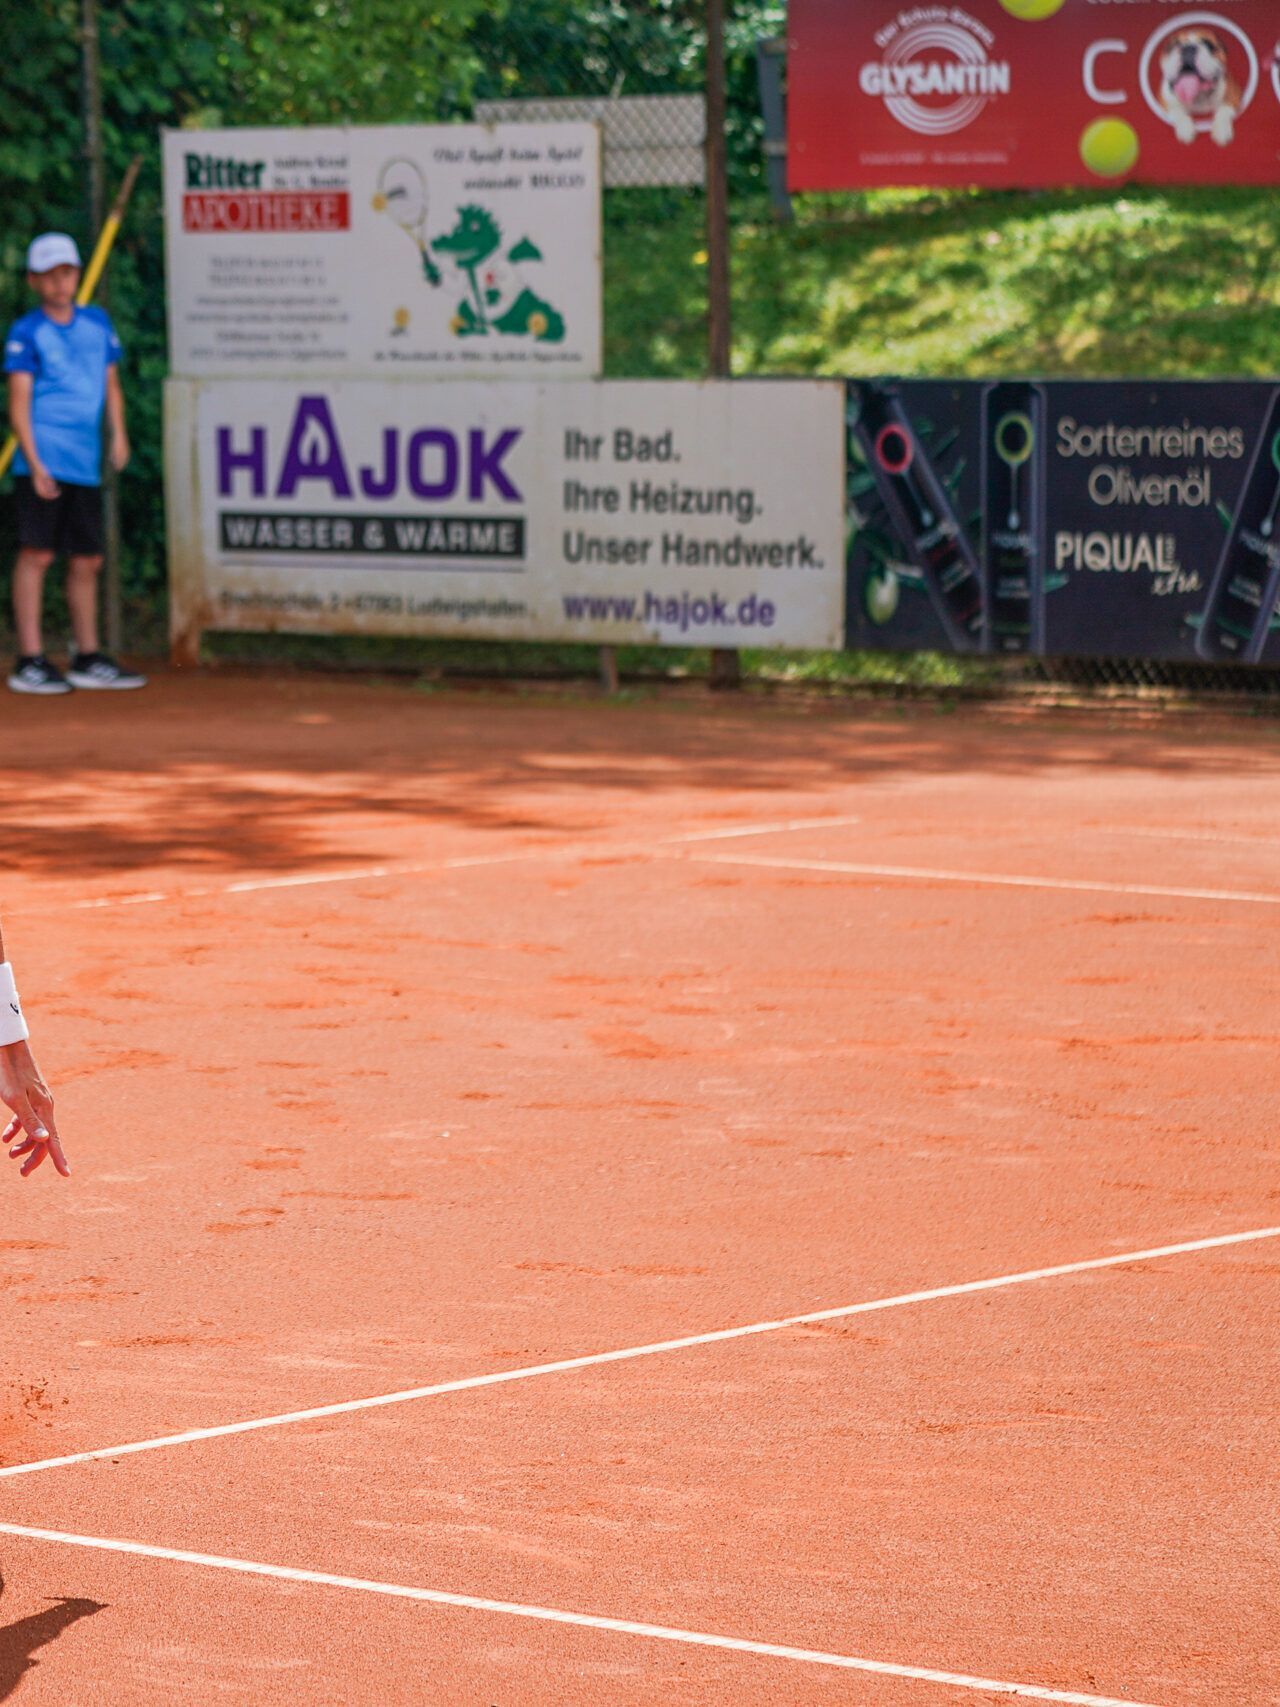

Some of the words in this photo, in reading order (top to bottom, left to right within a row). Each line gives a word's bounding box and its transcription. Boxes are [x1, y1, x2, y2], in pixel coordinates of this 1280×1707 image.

[859, 61, 1010, 96] GLYSANTIN
[1081, 11, 1280, 133] CO
[184, 152, 266, 190] Ritter
[185, 195, 342, 230] APOTHEKE
[217, 394, 525, 503] HAJOK
[563, 427, 604, 462] Ihr
[613, 428, 682, 463] Bad.
[1056, 415, 1245, 460] Sortenreines
[563, 480, 620, 513] Ihre
[629, 480, 763, 525] Heizung.
[1088, 463, 1212, 507] Olivenöl
[224, 517, 355, 549] WASSER
[363, 519, 386, 548] &
[563, 530, 652, 565] Unser
[661, 533, 825, 570] Handwerk.
[1054, 531, 1175, 572] PIQUAL
[562, 590, 777, 633] www.hajok.de
